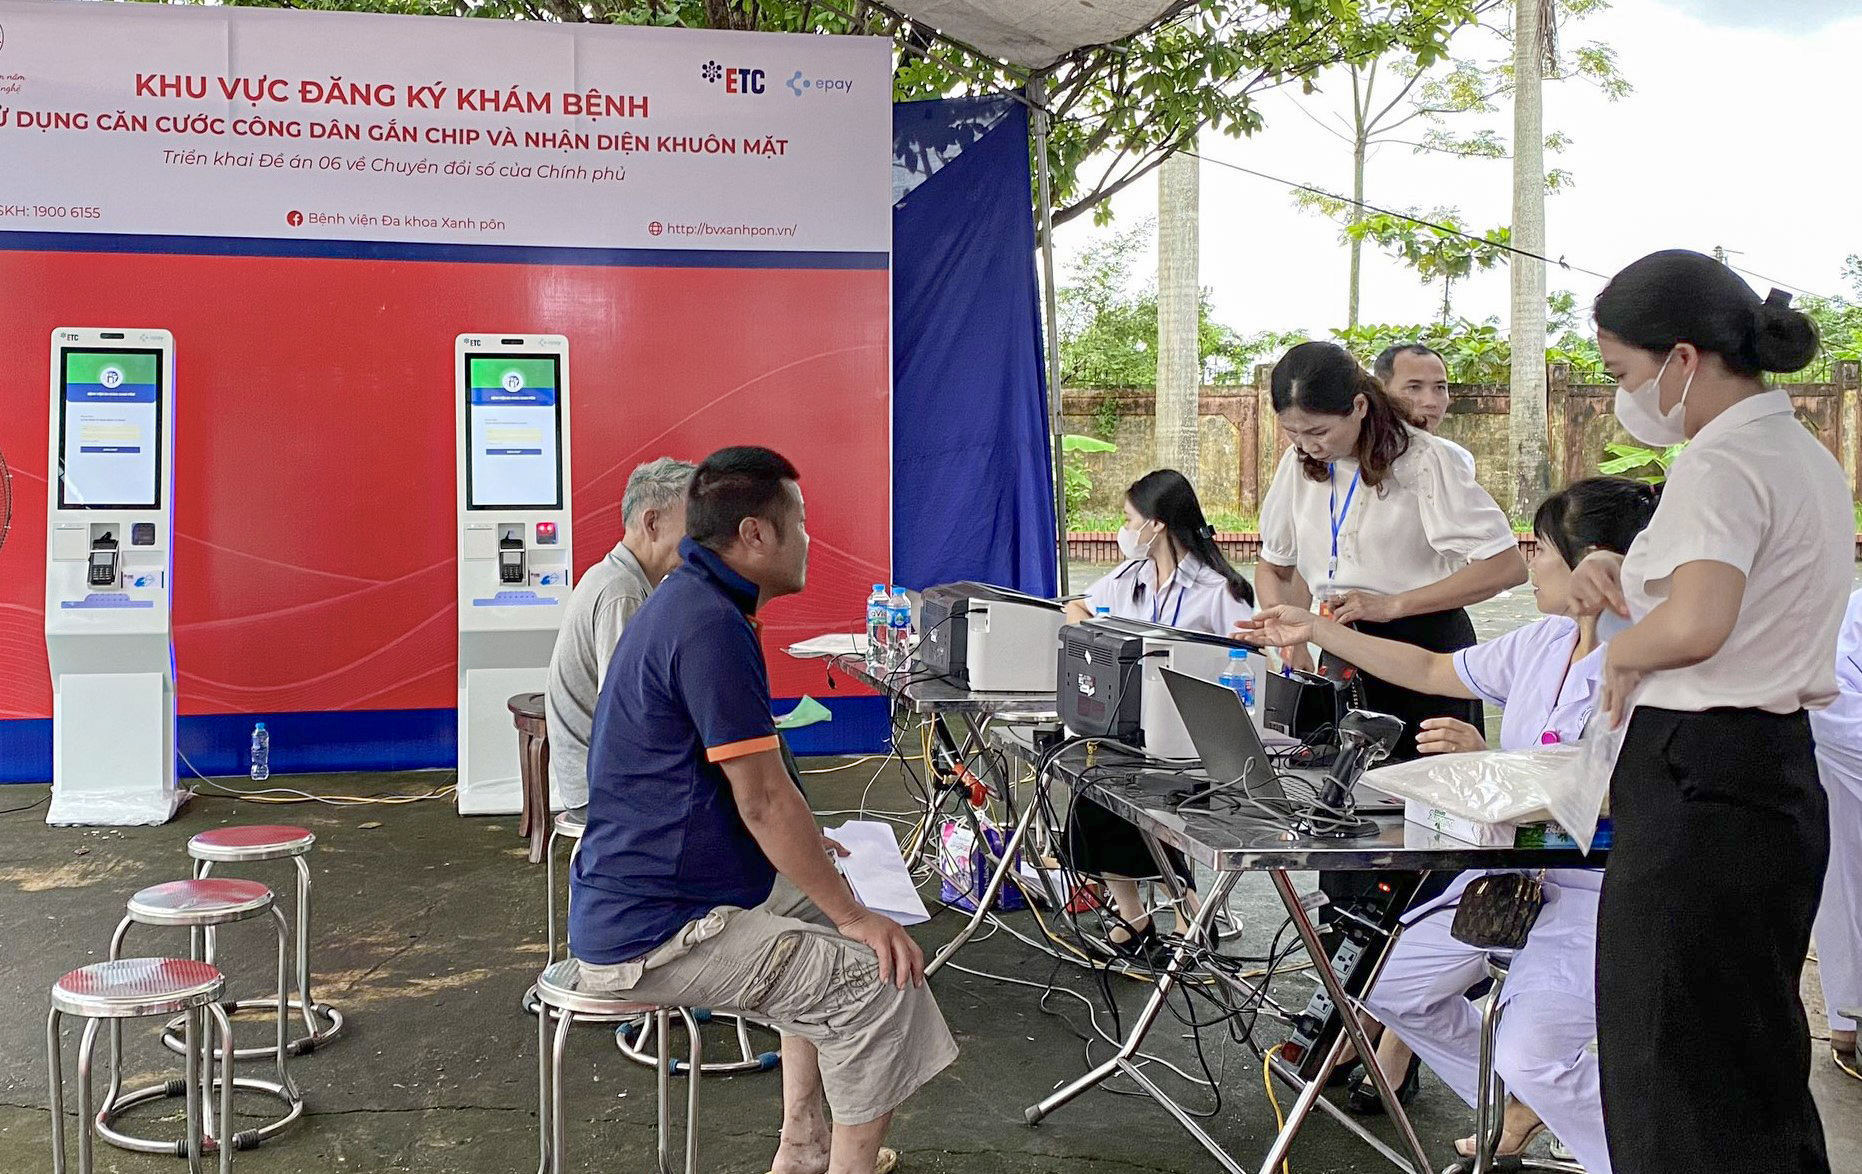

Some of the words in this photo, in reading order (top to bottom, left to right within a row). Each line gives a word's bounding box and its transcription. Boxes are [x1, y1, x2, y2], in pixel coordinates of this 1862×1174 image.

[726, 68, 766, 95] ETC
[815, 79, 853, 93] epay
[135, 73, 207, 99] KHU
[217, 74, 289, 107] VỰC
[298, 75, 396, 107] ĐĂNG
[407, 80, 447, 109] KÝ
[457, 84, 551, 114] KHÁM
[563, 88, 649, 122] BỆNH
[16, 110, 89, 133] DỤNG
[96, 109, 148, 132] CĂN
[155, 113, 226, 135] CƯỚC
[232, 115, 301, 138] CÔNG
[309, 118, 360, 140] DÂN
[367, 118, 418, 142] GẮN
[425, 127, 480, 145] CHIP
[486, 126, 518, 147] VÀ
[525, 128, 589, 153] NHẬN
[597, 131, 650, 155] DIỆN
[657, 133, 736, 154] KHUÔN
[743, 135, 788, 159] MẶT
[163, 149, 208, 165] Triển
[213, 151, 255, 167] khai
[259, 152, 285, 168] Đề
[289, 154, 313, 169] án
[318, 156, 342, 170] 06
[346, 155, 366, 171] về
[371, 157, 438, 176] Chuyển
[443, 160, 471, 175] đổi
[475, 161, 496, 176] số
[499, 162, 532, 178] của
[536, 164, 587, 181] Chính
[591, 166, 626, 183] phủ
[33, 206, 66, 218] 1900
[70, 207, 101, 219] 6155
[309, 212, 345, 227] Bệnh
[349, 213, 378, 228] viện
[381, 215, 400, 227] Đa
[404, 215, 438, 228] khoa
[441, 216, 476, 229] Xanh
[480, 218, 506, 231] pôn
[667, 222, 798, 238] http://bvxanhpon.vn/
[66, 333, 79, 342] ETC
[470, 339, 481, 347] ETC
